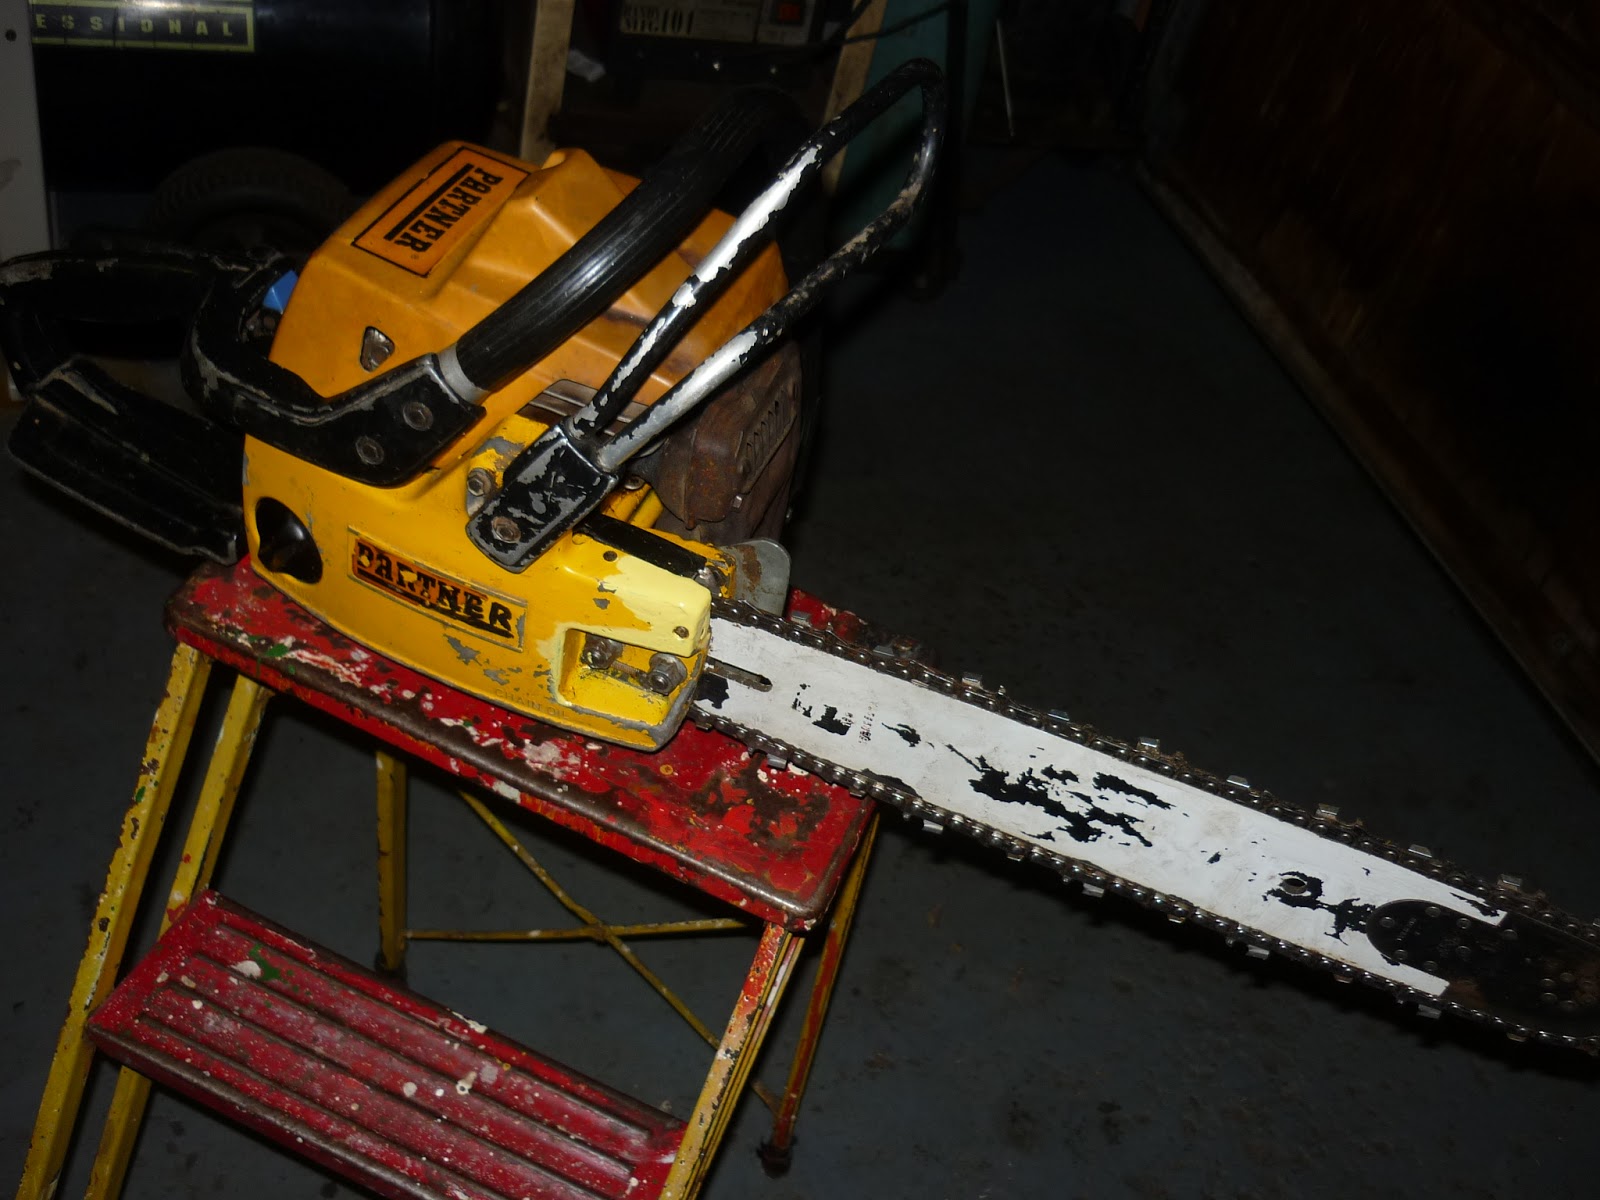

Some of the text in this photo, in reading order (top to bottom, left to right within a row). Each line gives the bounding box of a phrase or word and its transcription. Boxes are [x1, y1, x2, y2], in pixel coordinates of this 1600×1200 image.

[35, 13, 233, 38] ESSIONAL
[394, 167, 503, 253] PARTNER
[357, 541, 512, 631] PARTNER
[495, 688, 569, 720] CHAIN OIL
